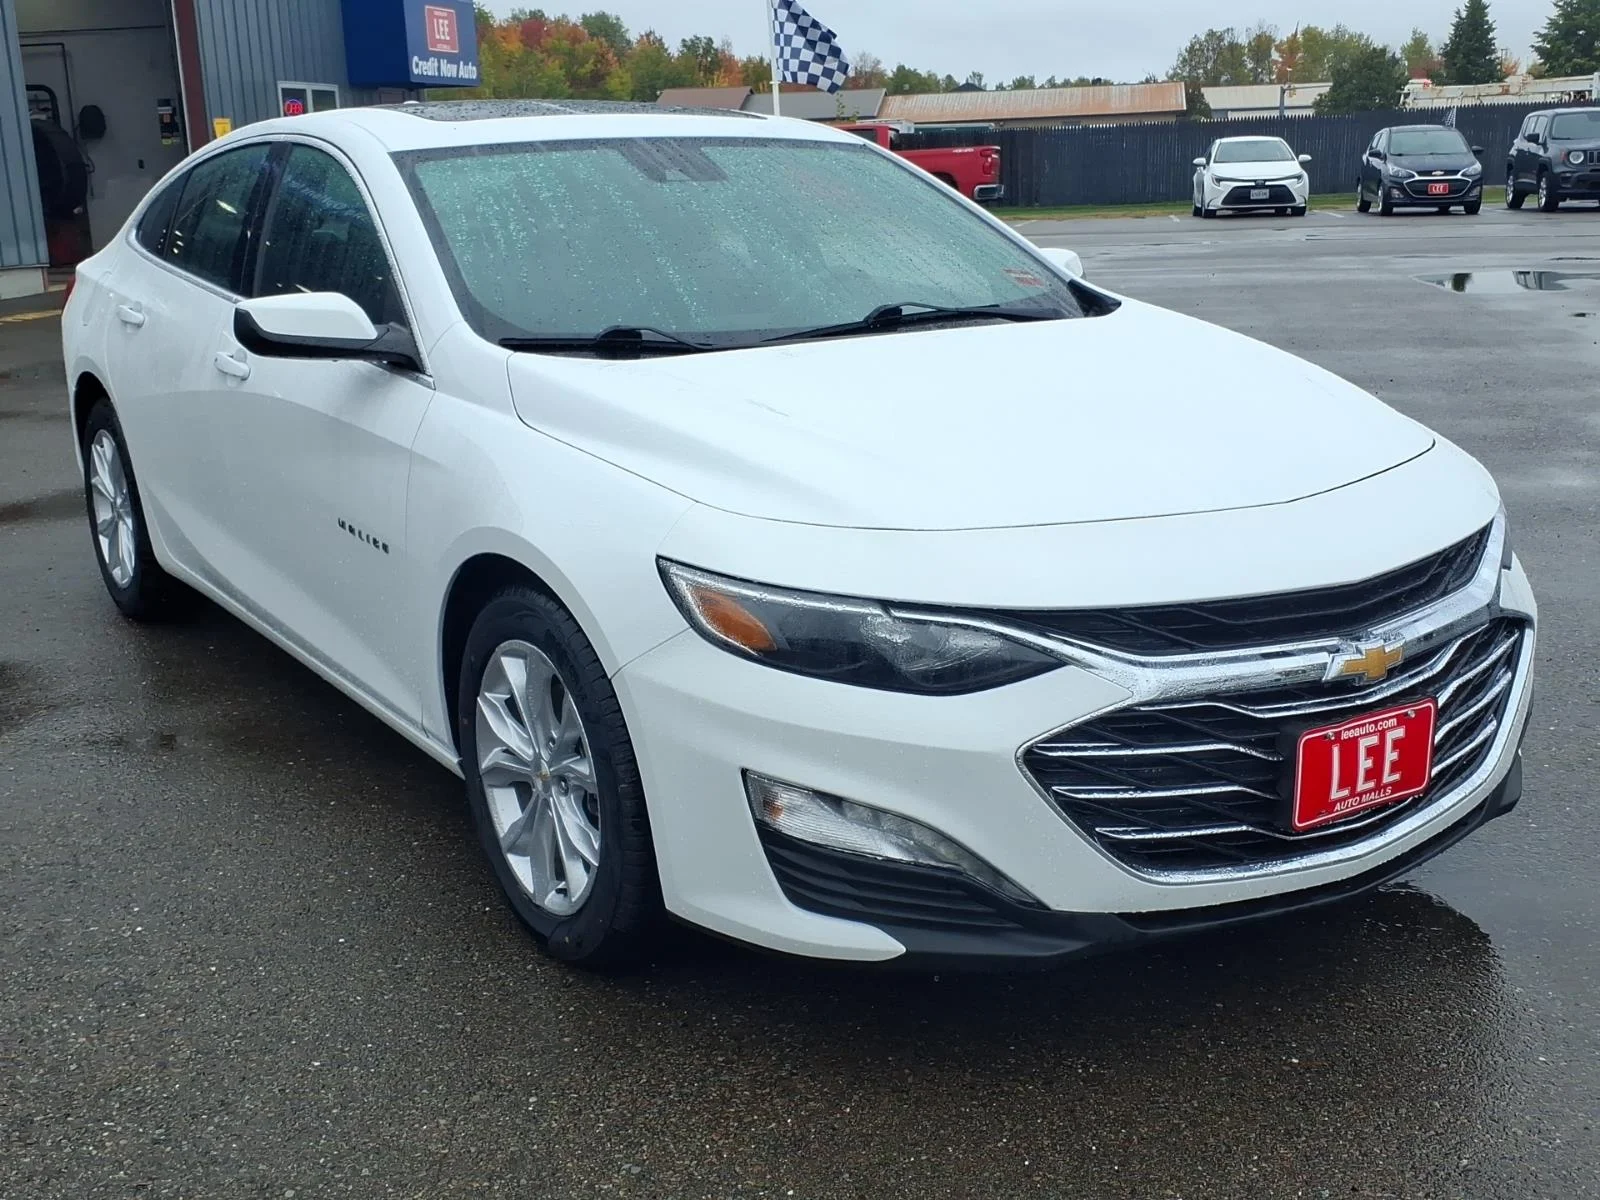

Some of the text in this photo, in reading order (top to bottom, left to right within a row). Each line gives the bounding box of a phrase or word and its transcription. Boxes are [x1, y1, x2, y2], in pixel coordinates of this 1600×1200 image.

[433, 18, 450, 40] LEE
[412, 56, 477, 79] Credit Now Auto
[1341, 718, 1397, 740] leeauto.com
[1330, 726, 1405, 801] LEE
[1334, 787, 1392, 812] AUTO MALLS
